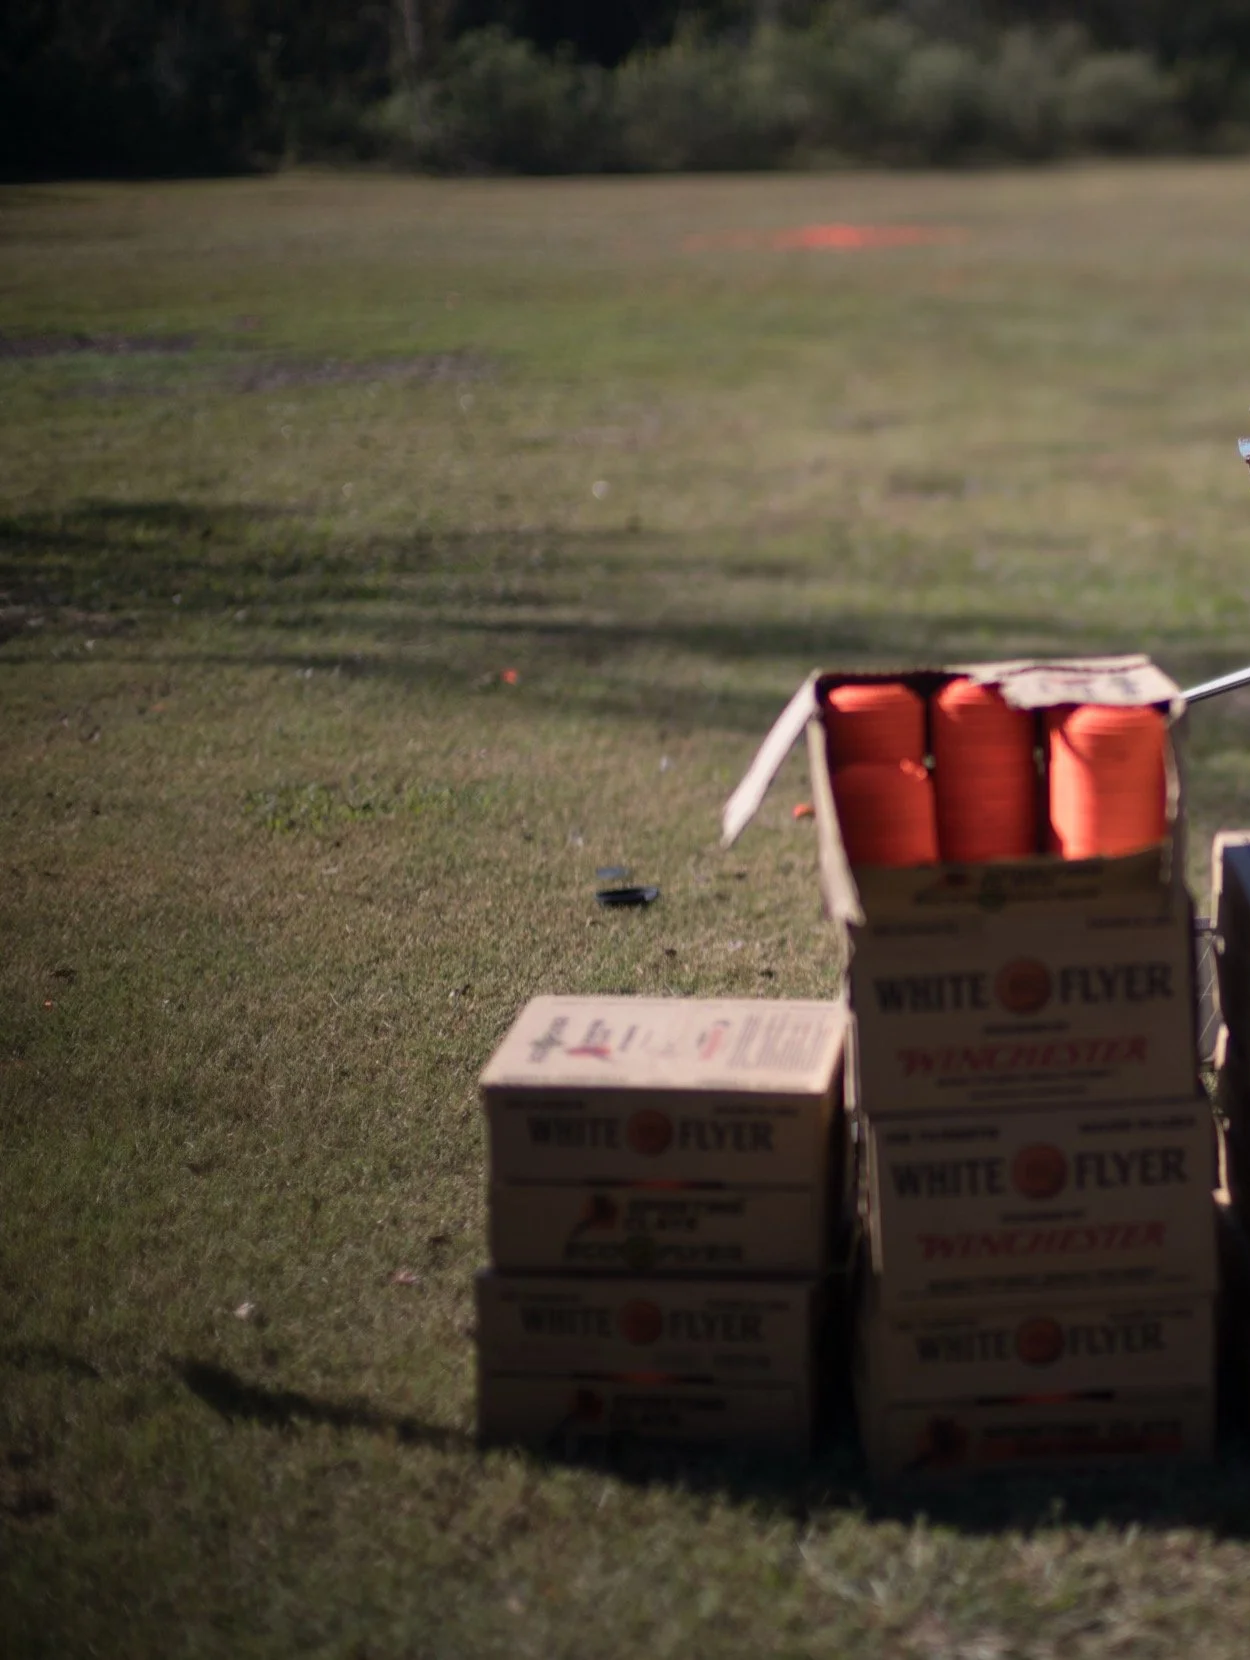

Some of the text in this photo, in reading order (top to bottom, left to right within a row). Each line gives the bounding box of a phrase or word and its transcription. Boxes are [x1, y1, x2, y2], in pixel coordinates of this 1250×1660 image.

[874, 962, 1175, 1013] WHITE FLYER
[896, 1035, 1149, 1077] WINCHESTER
[526, 1117, 774, 1151] WHITE FLYER
[890, 1147, 1188, 1198] WHITE FLYER
[917, 1221, 1166, 1261] WINCHESTER
[520, 1306, 764, 1342] WHITE FLYER
[915, 1322, 1166, 1363] WHITE FLYER
